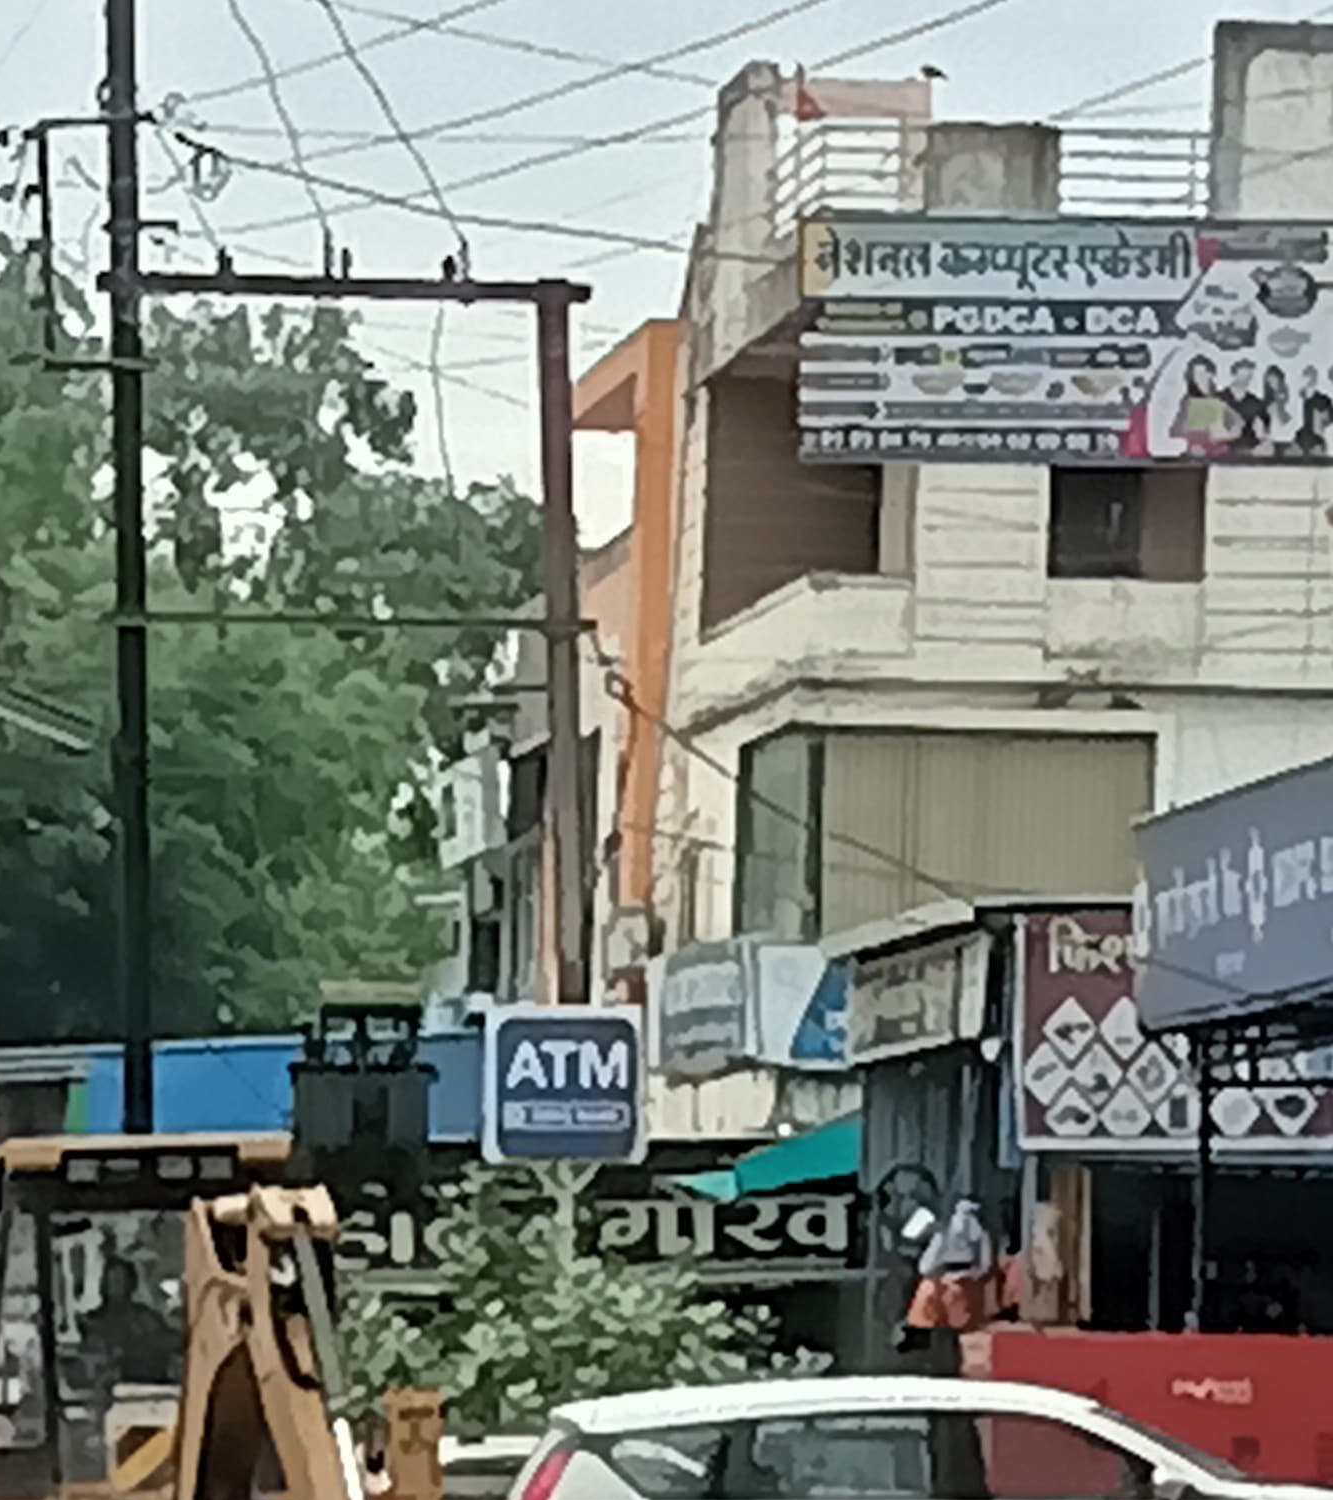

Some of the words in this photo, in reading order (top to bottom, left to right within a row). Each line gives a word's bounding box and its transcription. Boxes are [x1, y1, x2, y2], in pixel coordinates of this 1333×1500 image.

[933, 305, 1055, 334] PGDCA
[1085, 305, 1160, 334] DCA
[506, 1040, 628, 1089] ATM
